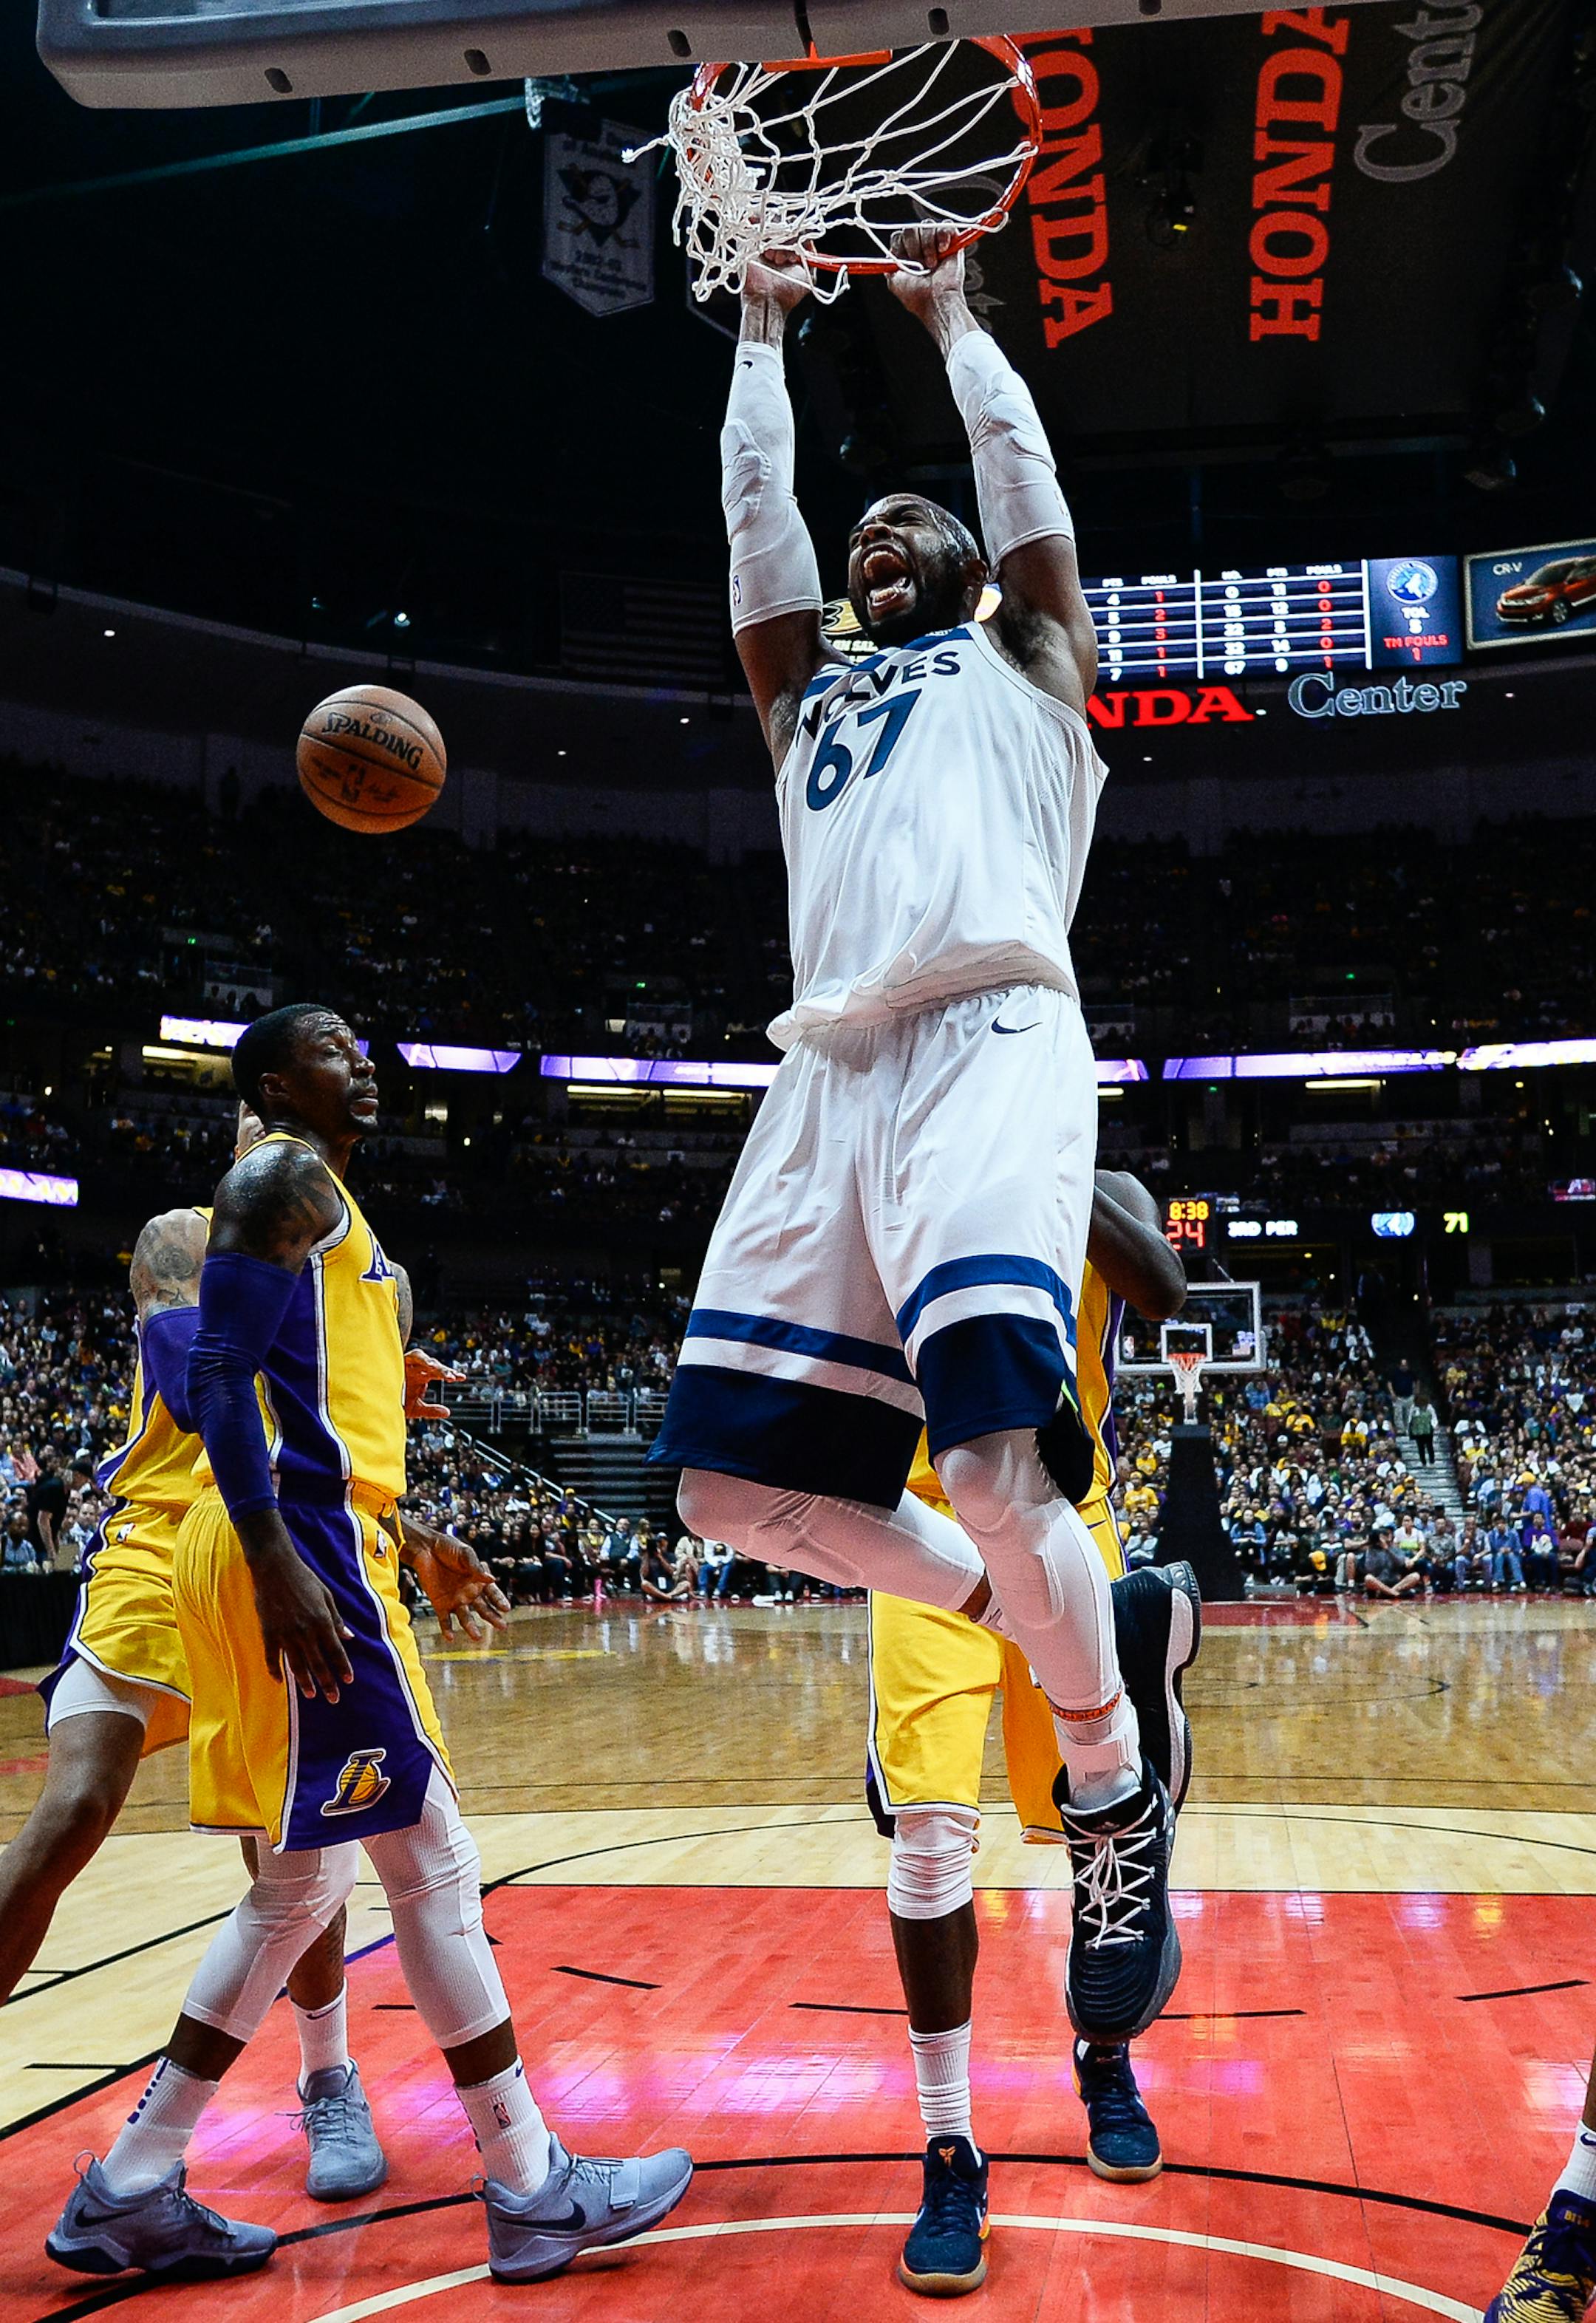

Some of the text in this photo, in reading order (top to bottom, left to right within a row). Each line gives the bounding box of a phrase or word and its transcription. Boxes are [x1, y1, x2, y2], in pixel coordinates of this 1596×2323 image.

[1493, 562, 1523, 576] CR-V
[1317, 580, 1331, 593] 0
[1154, 590, 1164, 603] 1
[1318, 599, 1331, 612] 0
[1155, 609, 1166, 621] 2
[1320, 618, 1332, 630] 2
[1155, 627, 1167, 640] 3
[851, 640, 879, 652] SAL
[1320, 637, 1333, 649] 0
[1383, 634, 1448, 649] TM FOULS
[1156, 647, 1166, 658] 1
[1411, 647, 1422, 662] 1
[1323, 655, 1333, 669] 1
[1110, 666, 1166, 681] 7 1
[1086, 671, 1467, 729] NDA Center
[321, 712, 423, 771] SPALDING
[806, 688, 923, 811] 67
[1170, 1201, 1209, 1221] 8:38
[1444, 1212, 1468, 1233] 71
[1166, 1221, 1205, 1251] 24
